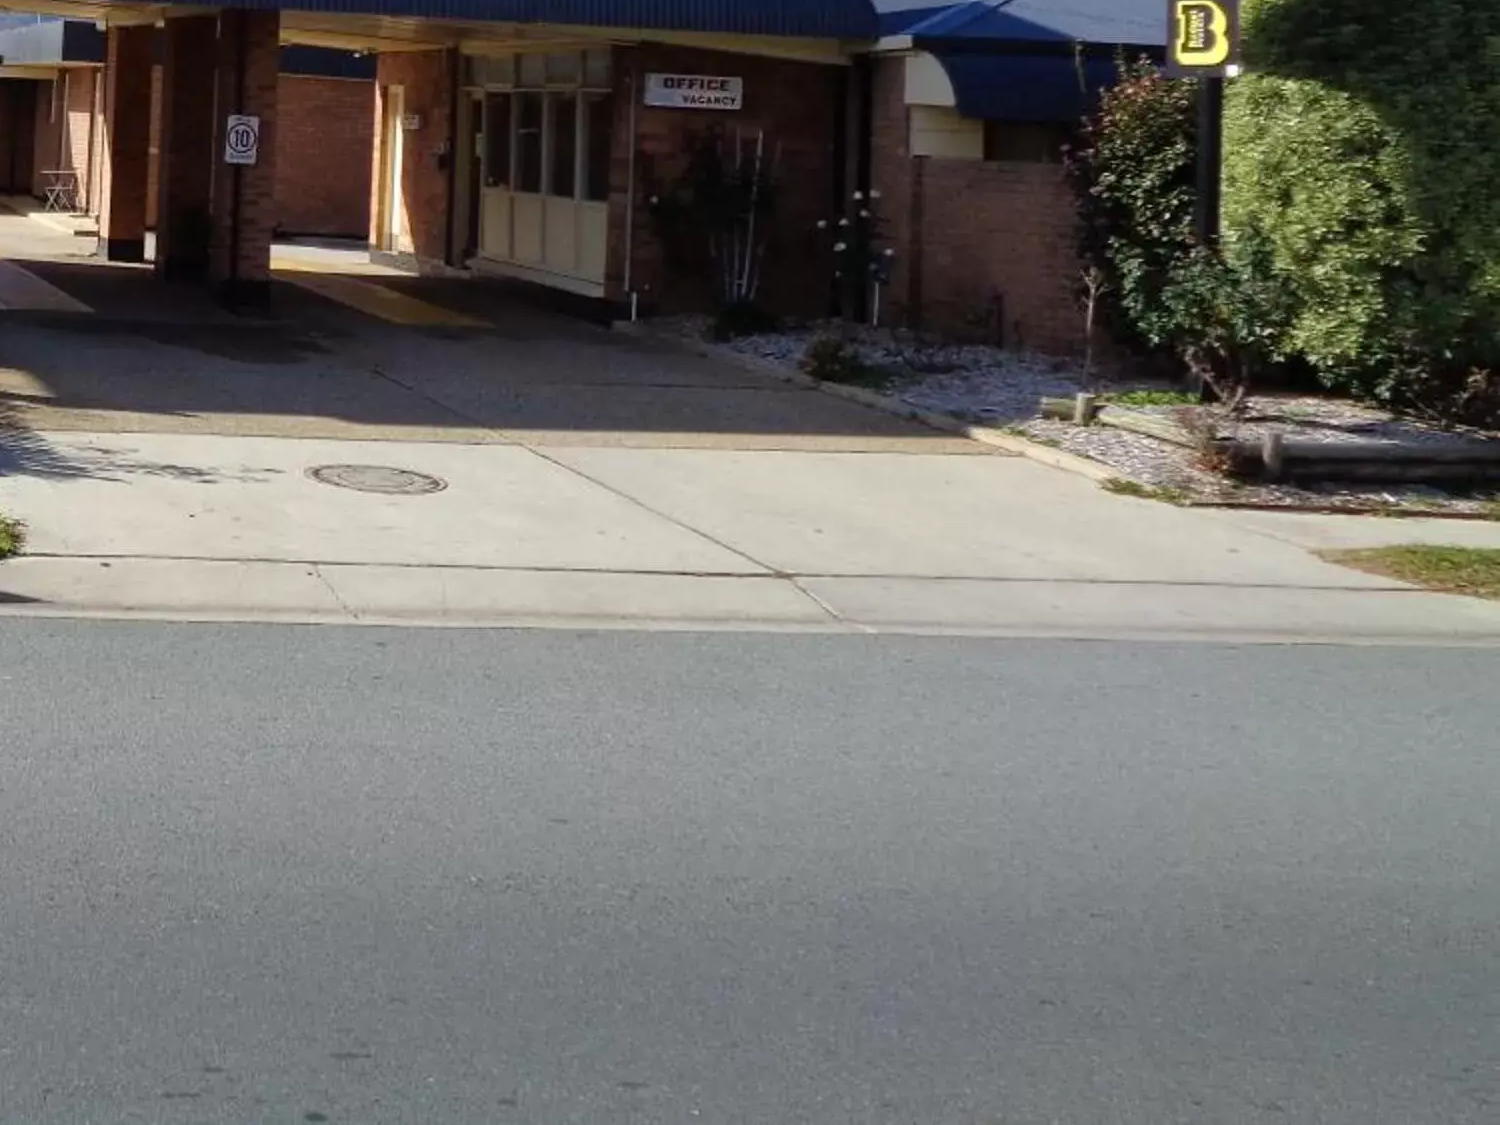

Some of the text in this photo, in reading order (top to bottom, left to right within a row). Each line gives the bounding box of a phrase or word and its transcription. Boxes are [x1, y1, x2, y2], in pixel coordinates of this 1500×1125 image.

[663, 76, 732, 92] OFFICE
[681, 94, 738, 106] VACANCY
[234, 128, 251, 148] 10
